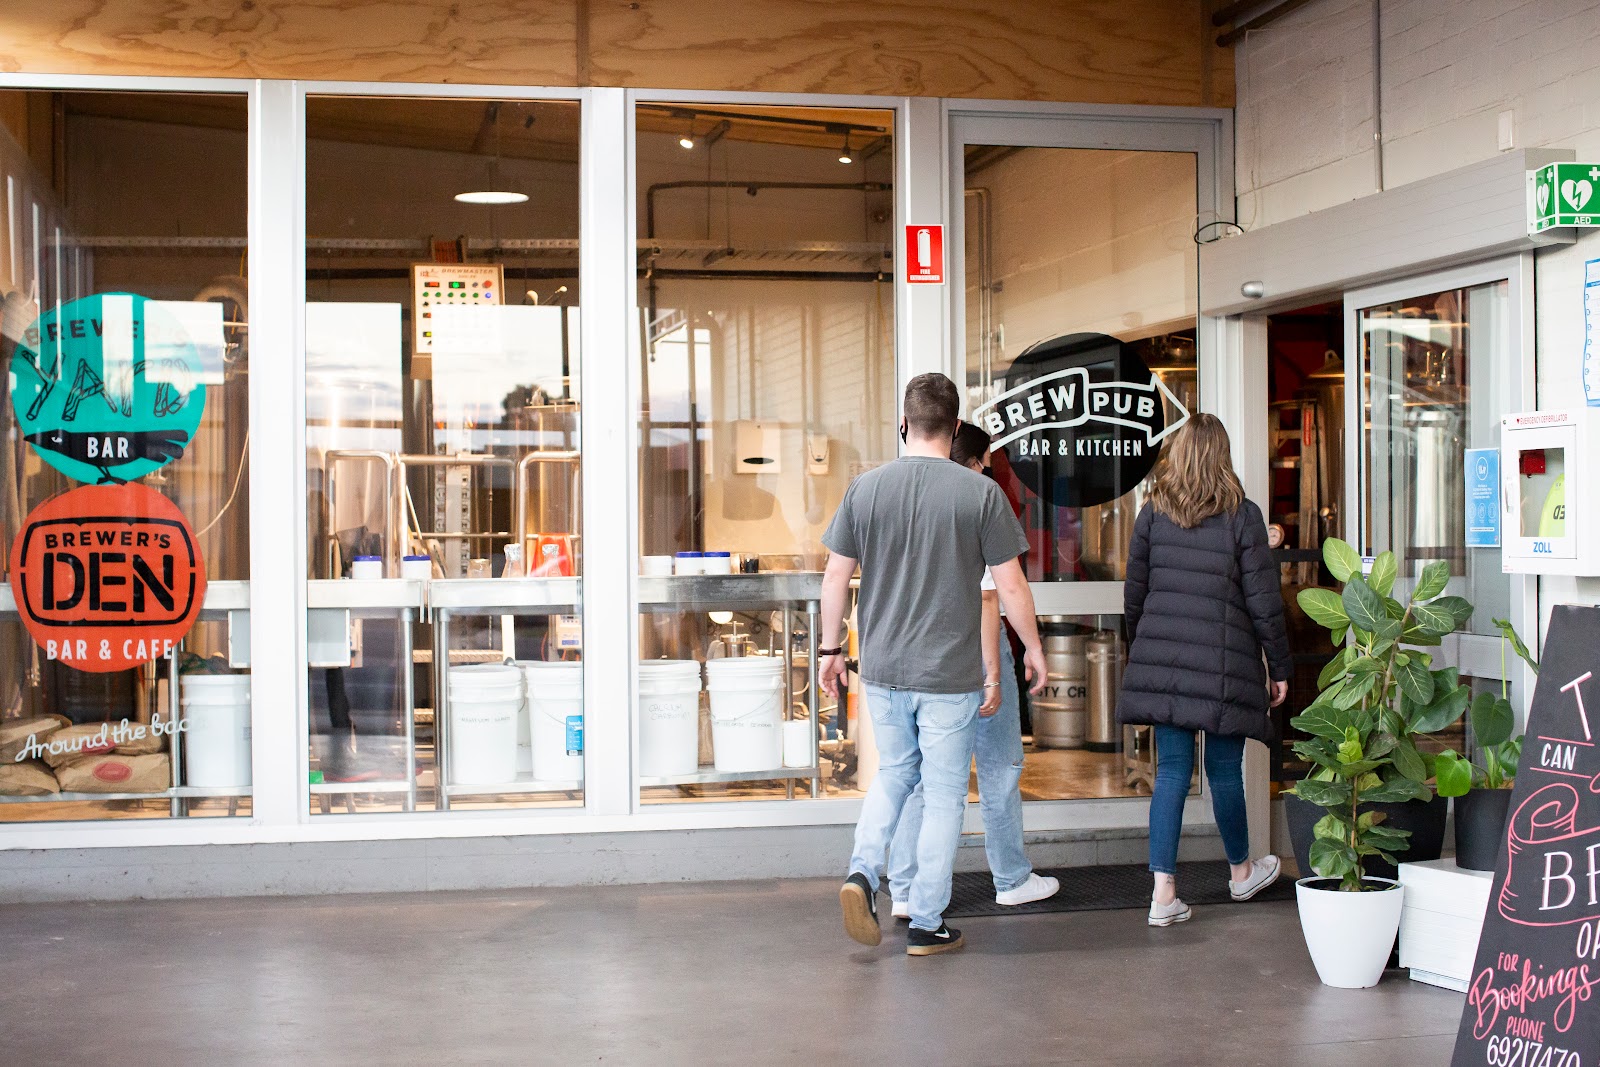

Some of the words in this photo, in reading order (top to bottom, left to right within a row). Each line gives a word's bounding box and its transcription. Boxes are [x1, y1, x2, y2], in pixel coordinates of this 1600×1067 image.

[1574, 216, 1591, 225] AED
[22, 350, 192, 422] YARD
[984, 382, 1077, 436] BREW
[1092, 391, 1155, 418] PUB
[87, 437, 129, 459] BAR
[1019, 439, 1051, 456] BAR
[1058, 439, 1068, 456] &
[1076, 439, 1142, 457] KITCHEN
[45, 531, 171, 549] BREWER'S
[1533, 542, 1552, 553] ZOLL
[42, 552, 175, 613] DEN
[46, 639, 88, 660] BAR
[99, 639, 111, 660] &
[123, 639, 172, 660] CAFE
[15, 722, 108, 762] Around
[112, 718, 147, 743] the
[1541, 743, 1577, 771] CAN
[1498, 952, 1519, 972] FOR
[1469, 958, 1600, 1040] Bookings
[1505, 1016, 1546, 1043] PHONE
